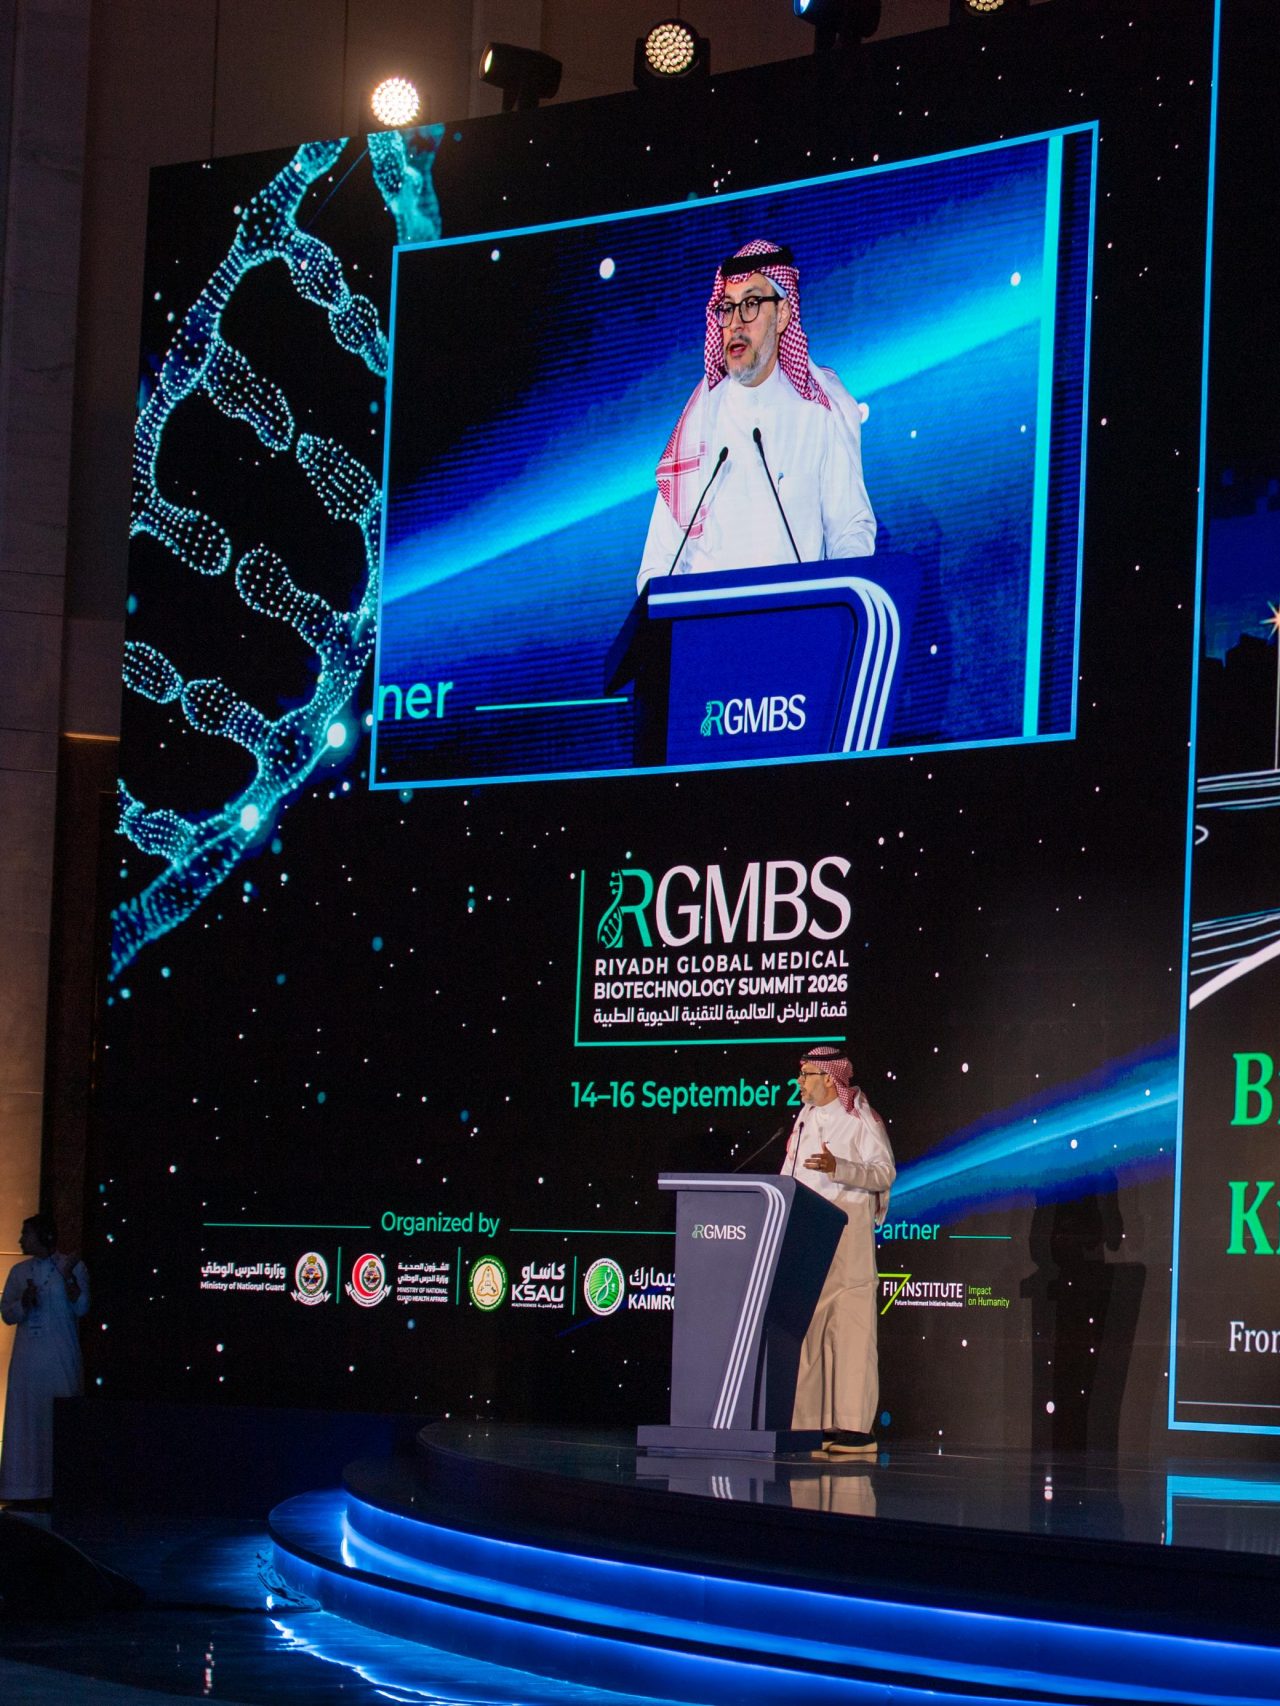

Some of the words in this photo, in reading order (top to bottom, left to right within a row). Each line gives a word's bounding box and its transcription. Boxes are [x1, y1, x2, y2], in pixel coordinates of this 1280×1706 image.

[700, 694, 806, 736] RGMBS
[597, 856, 851, 949] RGMBS
[595, 956, 669, 976] RIYADH
[676, 954, 754, 974] GLOBAL
[761, 949, 850, 970] MEDICAL
[593, 978, 736, 1000] BIOTECHNOLOGY
[738, 973, 805, 996] SUMMIT
[807, 973, 848, 993] 2026
[593, 1006, 635, 1027] الطبية
[636, 1005, 679, 1027] الحيوية
[681, 1004, 724, 1026] للتقنية
[725, 1002, 775, 1025] العالمية
[776, 1001, 818, 1023] الرياض
[820, 1000, 848, 1018] قمة
[641, 1078, 780, 1114] September
[381, 1210, 474, 1236] Organized
[478, 1211, 500, 1238] by
[691, 1224, 747, 1240] RGMBS
[233, 1263, 263, 1278] الحرس
[263, 1263, 286, 1279] وزارة
[200, 1280, 228, 1291] Ministry
[228, 1281, 236, 1290] of
[236, 1282, 264, 1291] National
[264, 1283, 285, 1291] Guard
[511, 1283, 565, 1302] KSAU
[968, 1285, 992, 1297] Impact
[967, 1298, 977, 1306] on
[977, 1296, 1010, 1308] Humanity
